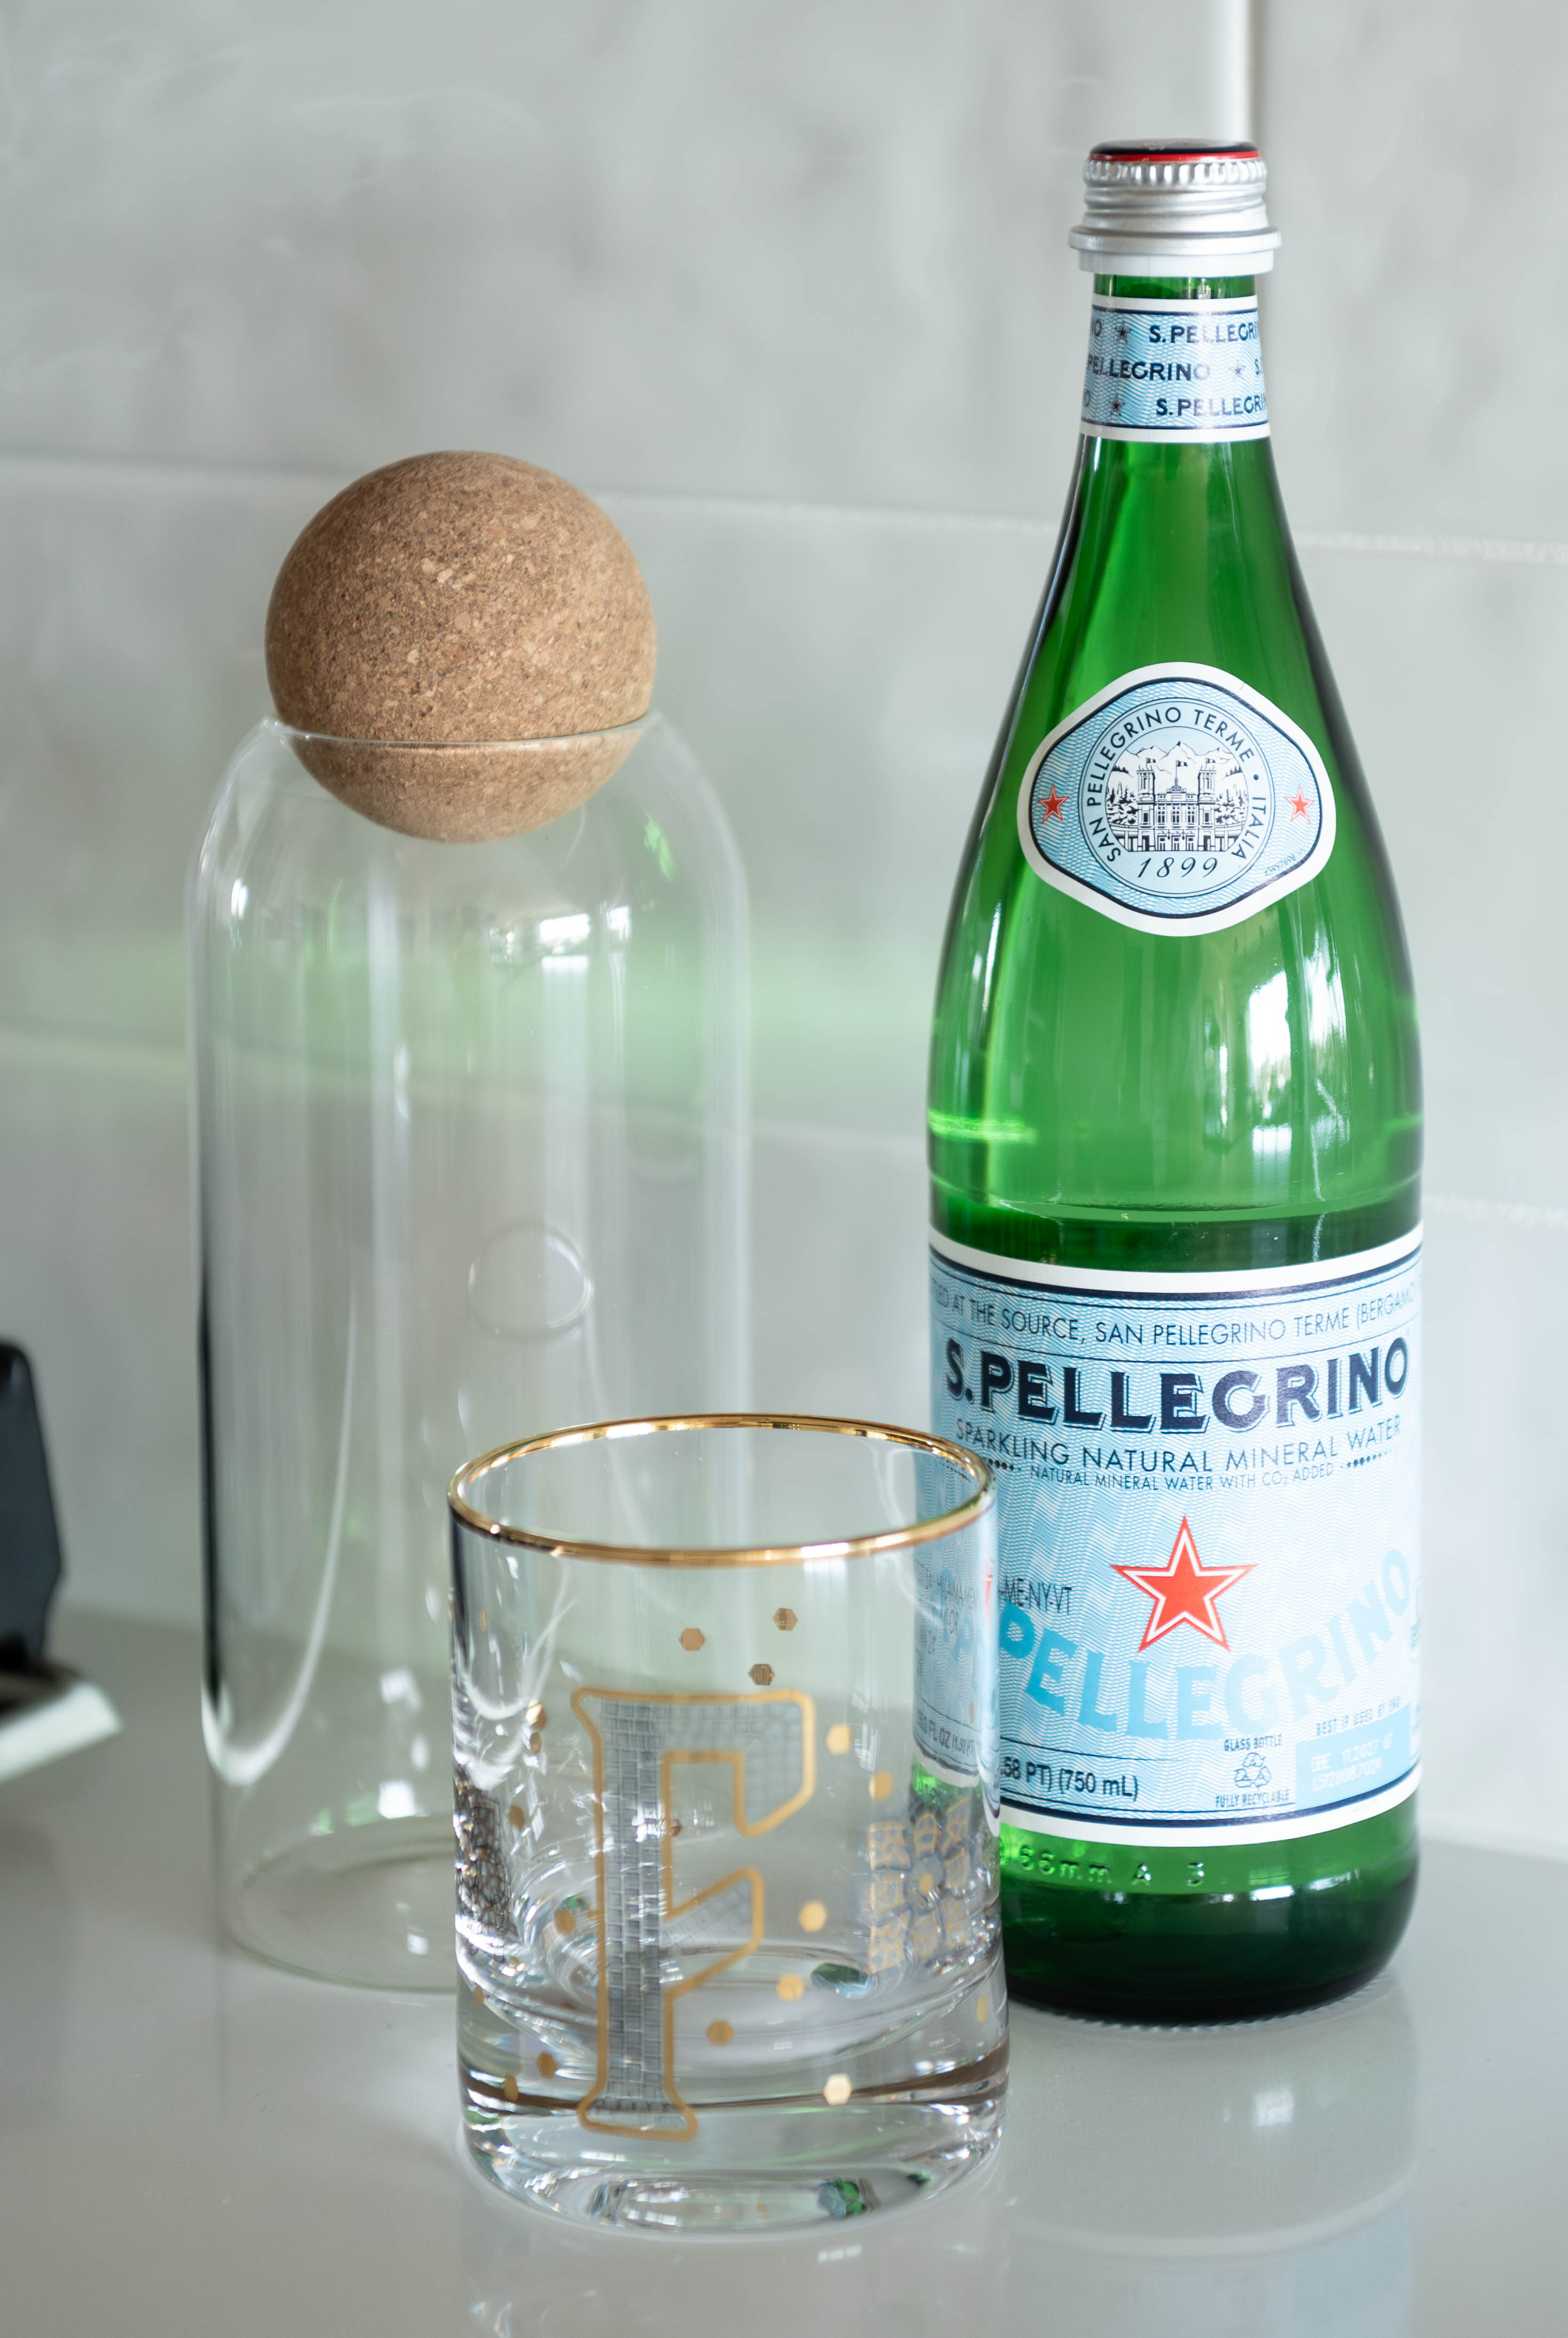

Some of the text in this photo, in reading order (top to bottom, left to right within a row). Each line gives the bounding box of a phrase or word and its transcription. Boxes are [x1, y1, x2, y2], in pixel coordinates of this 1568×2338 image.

[1087, 706, 1254, 862] SAN PELLEGRINO TERME
[1231, 796, 1266, 861] ITALIA
[1137, 856, 1218, 878] 1899
[970, 1299, 995, 1326] THE
[1002, 1308, 1085, 1344] SOURCE,
[1096, 1321, 1142, 1345] SAN
[1154, 1319, 1285, 1345] PELLEGRINO
[1294, 1308, 1350, 1337] TERME
[946, 1337, 1409, 1434] S.PELLEGRINO
[956, 1414, 1401, 1473] SPARKLING NATURAL MINERAL WATER
[1030, 1464, 1089, 1487] NATURAL
[1095, 1473, 1159, 1491] MINERAL
[1165, 1475, 1213, 1491] WATER
[1220, 1473, 1256, 1489] WITH
[1293, 1463, 1334, 1482] ADDED
[1224, 1734, 1282, 1752] GLASS BOTTLE
[1026, 1761, 1052, 1792] PT)
[1059, 1768, 1096, 1794] (750
[1102, 1775, 1138, 1802] mL)
[1216, 1788, 1290, 1809] FULLY RECYCLABLE
